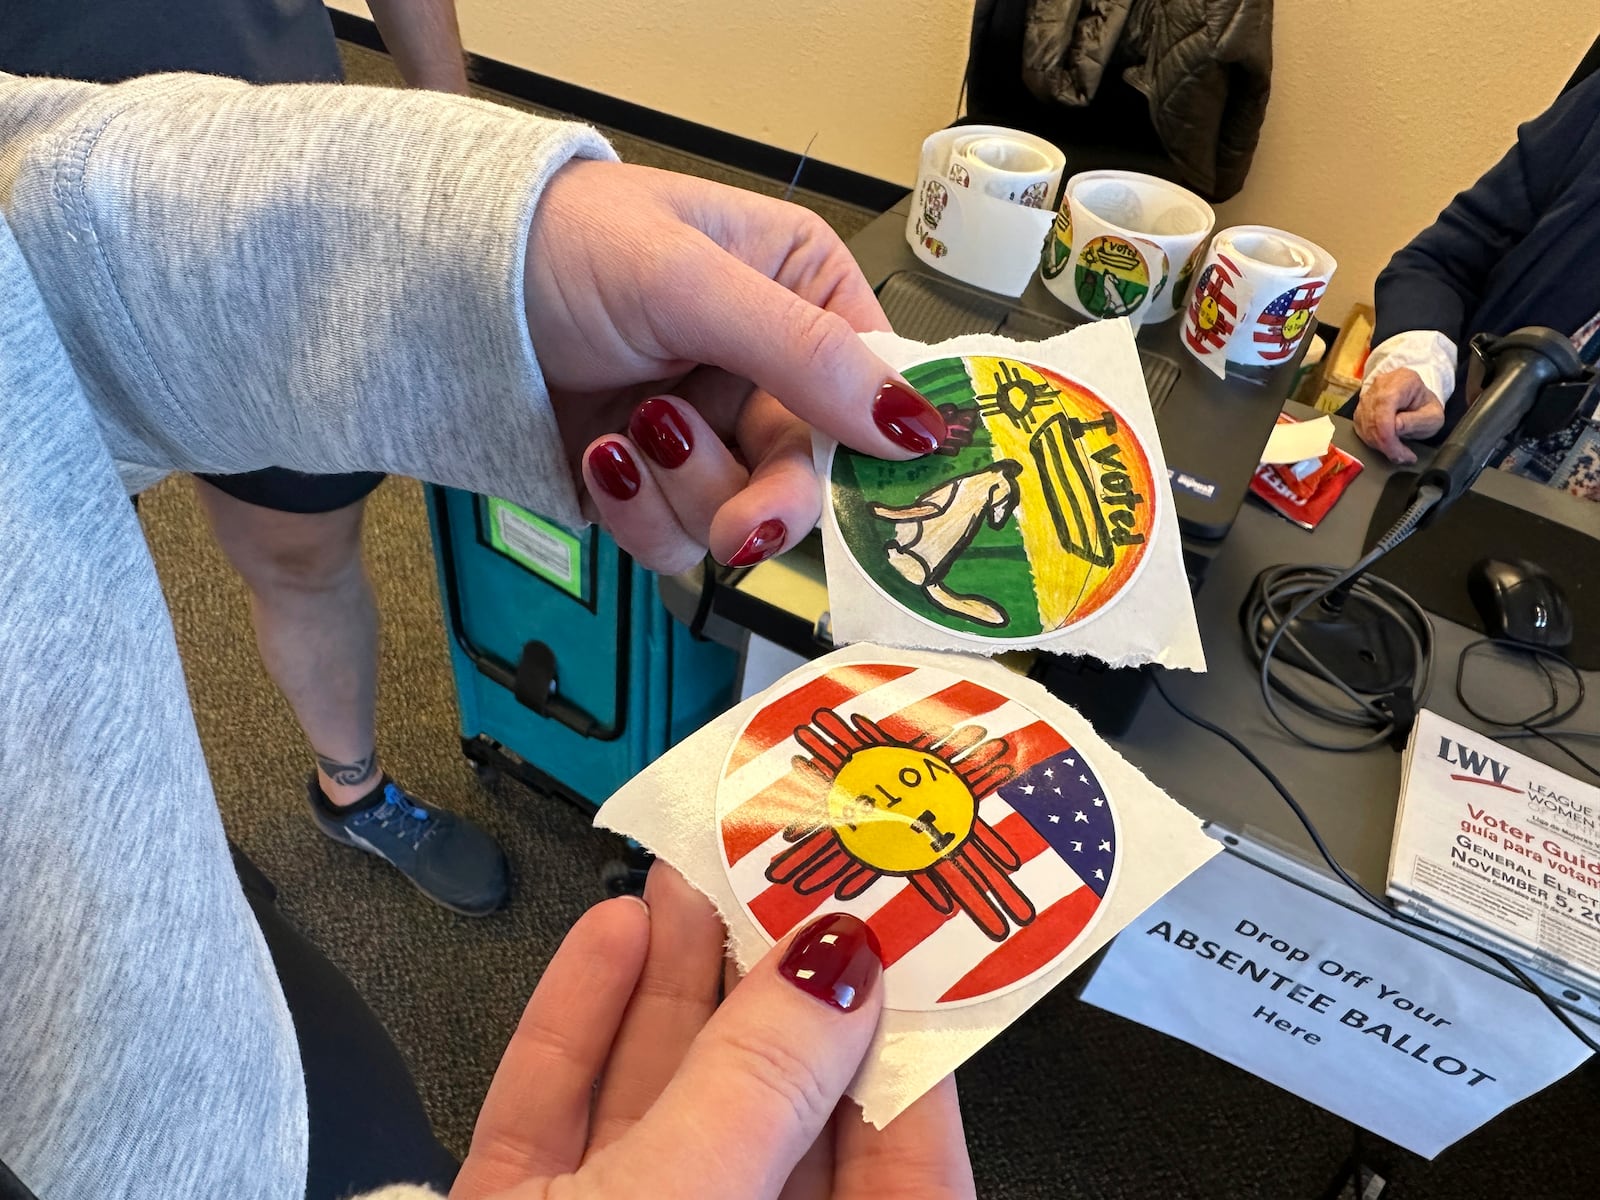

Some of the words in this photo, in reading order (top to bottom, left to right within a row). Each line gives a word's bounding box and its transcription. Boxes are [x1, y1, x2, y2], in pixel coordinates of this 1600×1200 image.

[1437, 735, 1511, 785] LWV
[1467, 802, 1536, 844] Voter
[1527, 780, 1593, 818] LEAGUE
[1527, 791, 1595, 829] WOMEN
[1451, 846, 1548, 901] NOVEMBER
[1555, 893, 1574, 914] 5,
[1456, 834, 1538, 881] GENERAL
[1543, 873, 1599, 908] ELECT
[1460, 820, 1499, 843] guía
[1503, 838, 1543, 865] para
[1547, 858, 1600, 890] votan
[1146, 919, 1337, 1015] ABSENTEE
[1339, 1006, 1497, 1089] BALLOT
[1235, 919, 1310, 963] Drop
[1318, 959, 1374, 989] Off
[1376, 982, 1453, 1030] Your
[1252, 1004, 1323, 1046] Here
